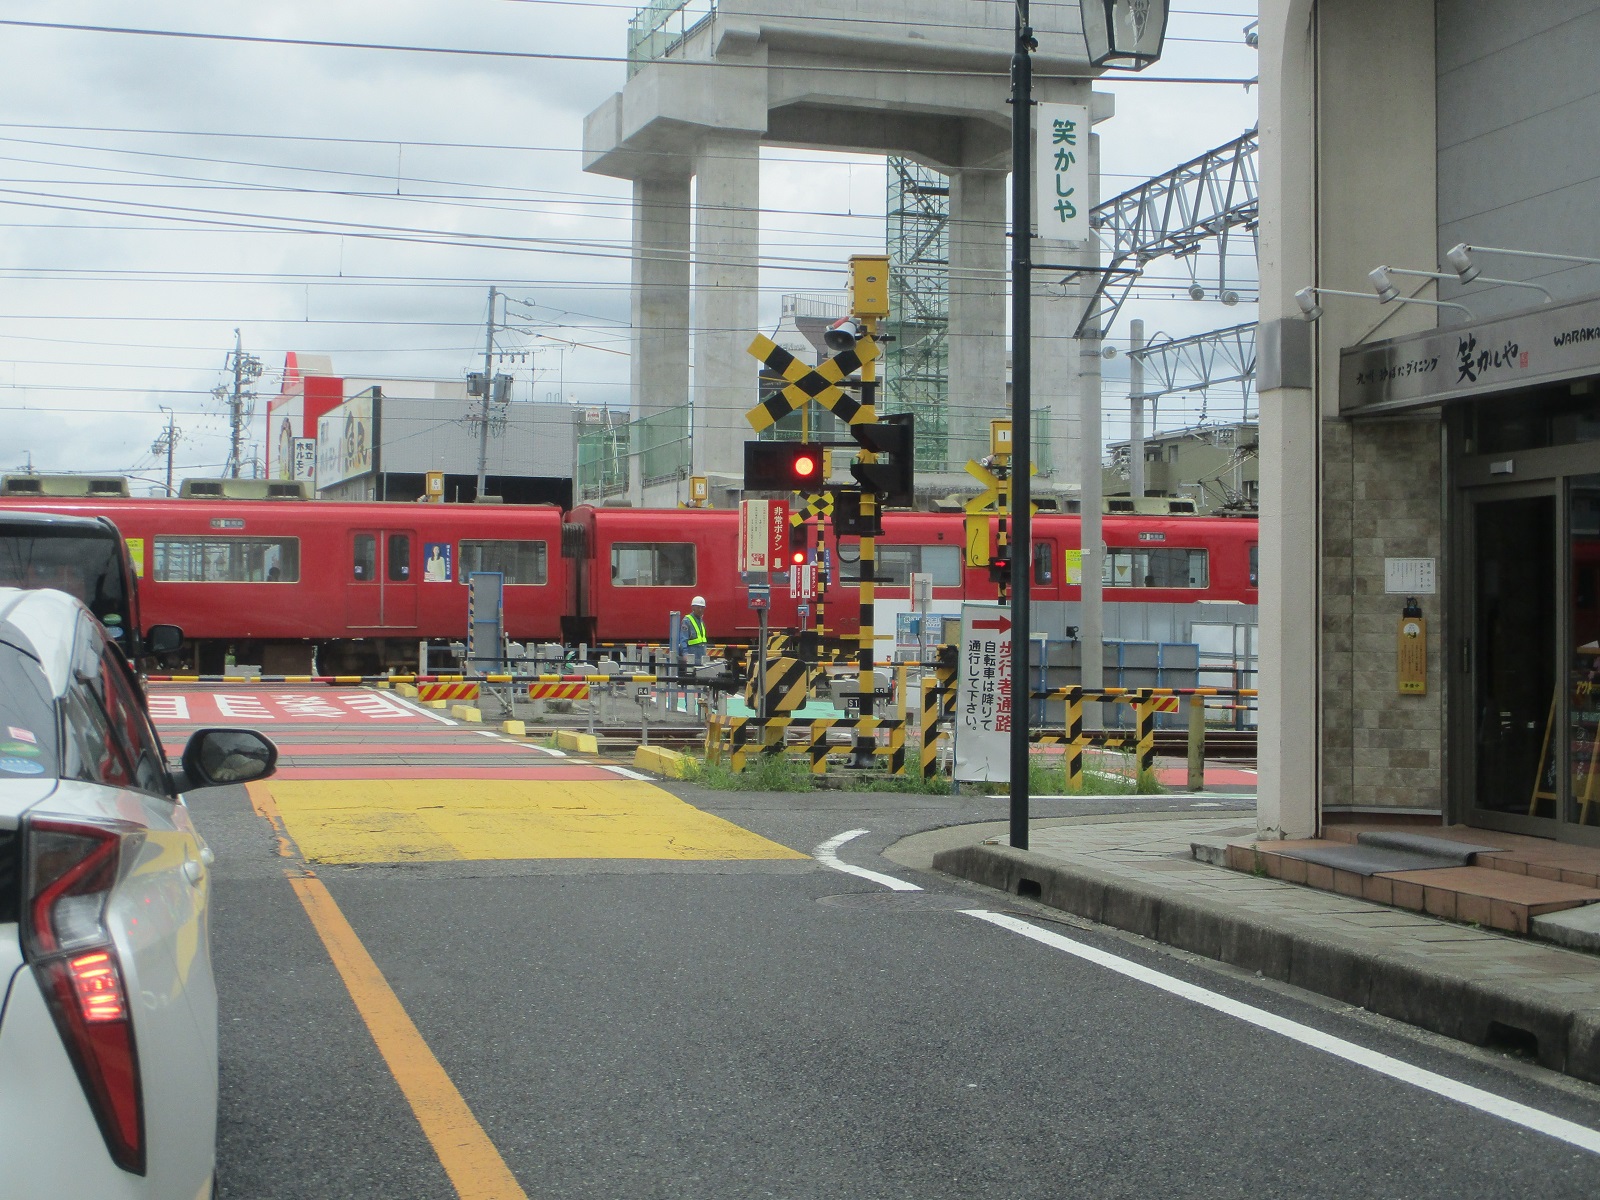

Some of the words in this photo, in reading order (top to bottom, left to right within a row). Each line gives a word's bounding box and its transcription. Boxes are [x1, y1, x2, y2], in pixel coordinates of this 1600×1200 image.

[1053, 119, 1076, 222] 笑かしや
[1456, 332, 1518, 384] 笑かしや
[296, 442, 304, 476] ホルモン
[305, 443, 313, 460] 知立
[774, 506, 783, 551] 非常ボタン
[848, 700, 858, 708] S1
[965, 639, 981, 731] 通行して下さい。
[981, 640, 996, 731] 自転車は降りて
